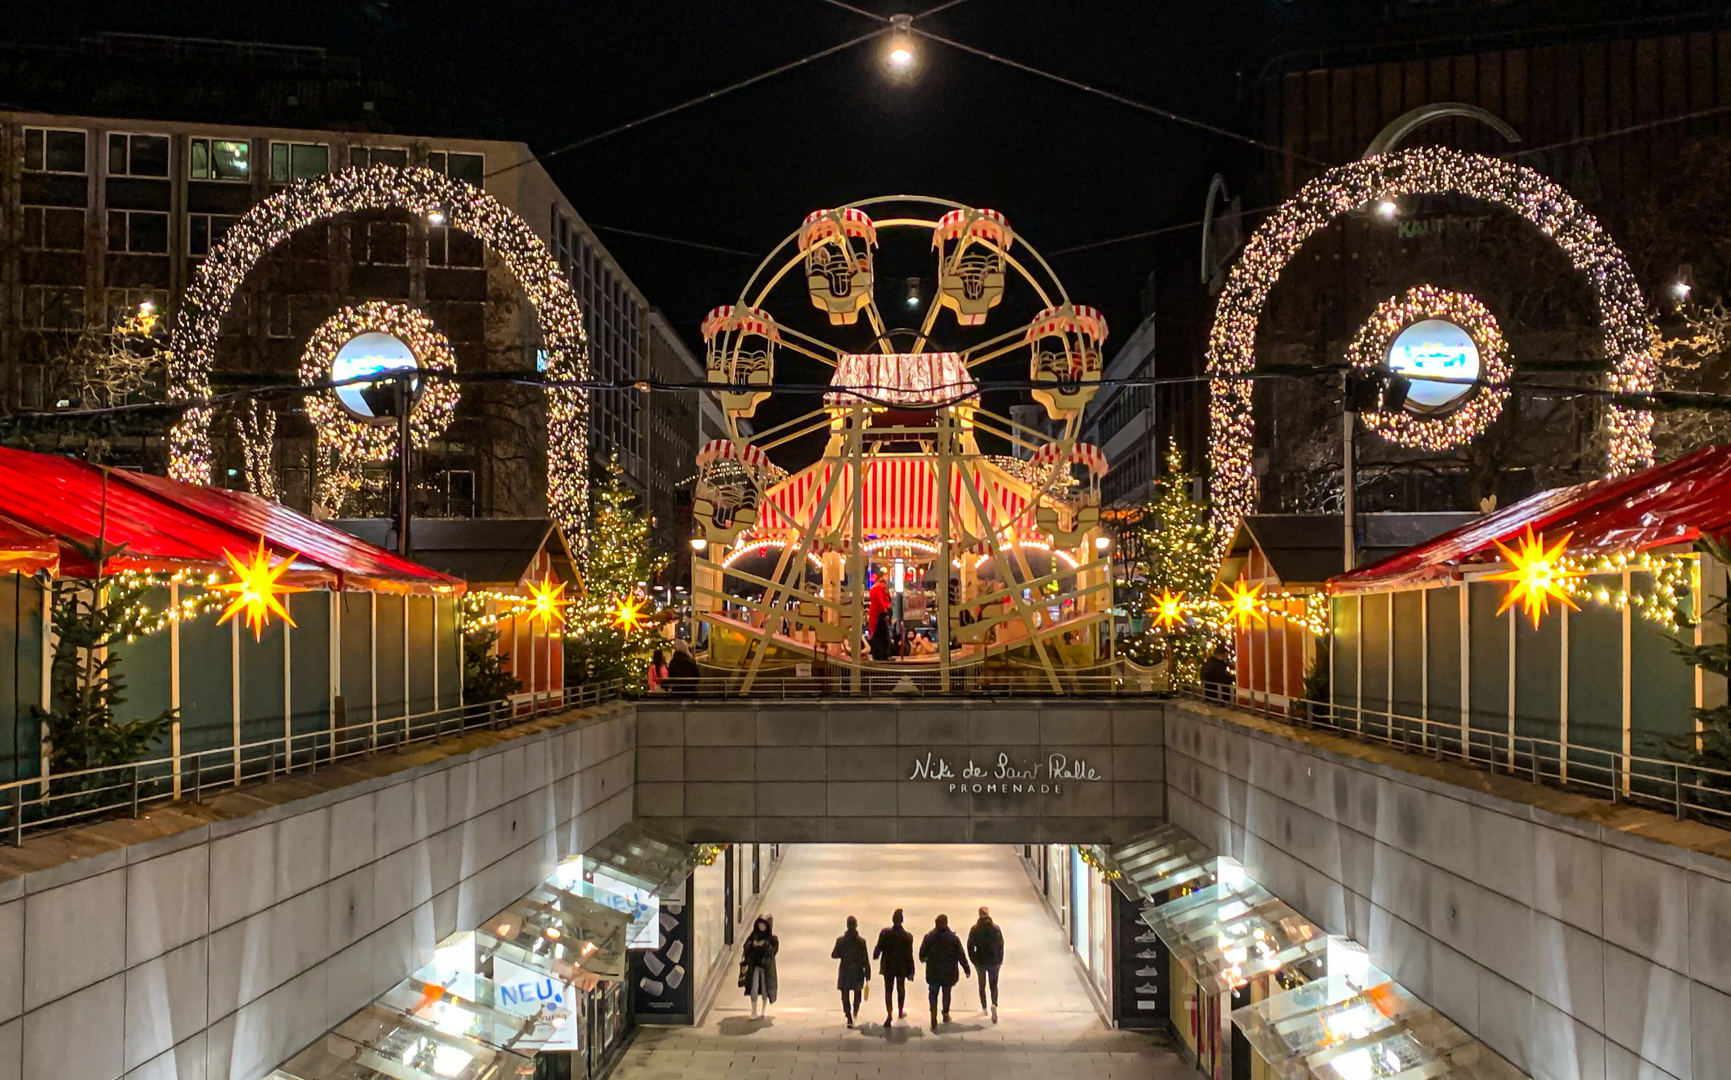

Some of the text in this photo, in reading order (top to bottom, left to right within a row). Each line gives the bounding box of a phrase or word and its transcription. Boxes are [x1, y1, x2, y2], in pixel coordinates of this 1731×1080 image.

[909, 752, 955, 781] Niki
[962, 760, 987, 779] de
[994, 752, 1043, 780] Saint
[949, 783, 1062, 794] PROMENADE
